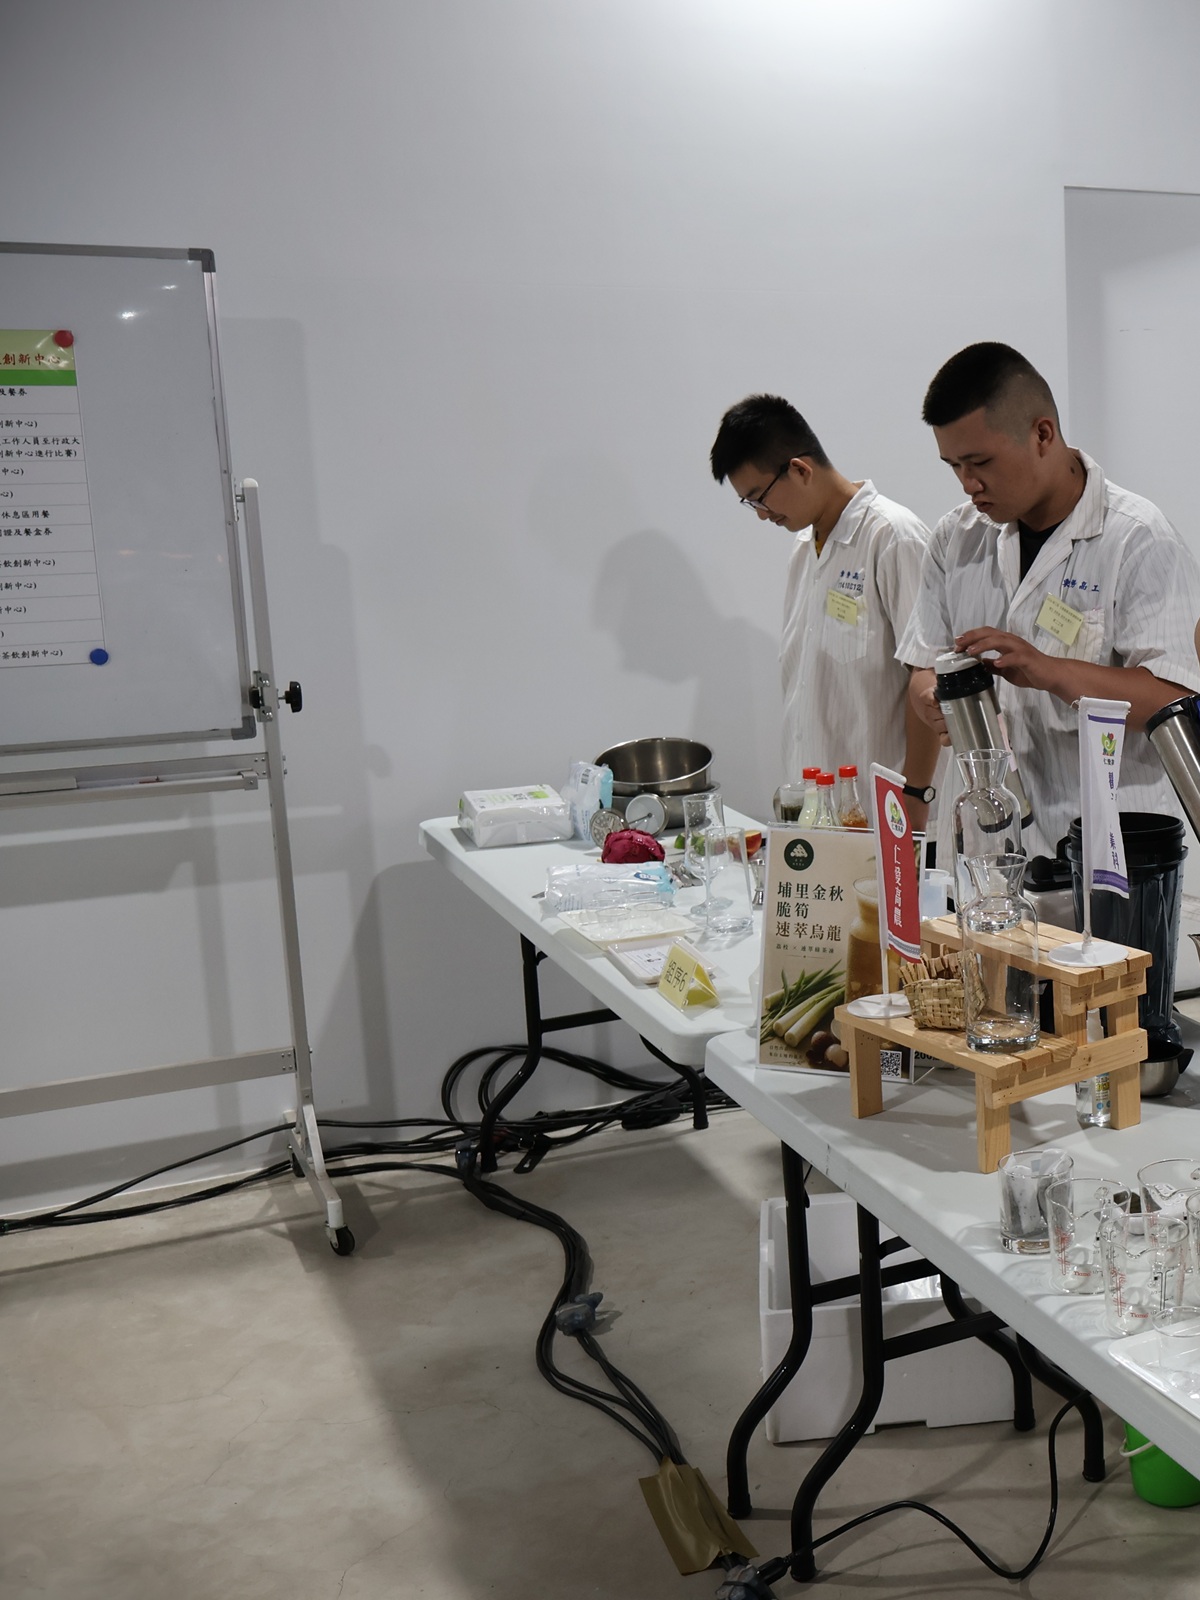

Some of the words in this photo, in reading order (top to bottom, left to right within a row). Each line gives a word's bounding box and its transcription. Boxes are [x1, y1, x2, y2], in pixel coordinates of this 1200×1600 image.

[0, 353, 61, 366] 創新中心
[0, 436, 80, 446] 工作人員至行政大
[0, 527, 52, 537] 證及餐盒券
[0, 558, 56, 568] 飲創新中心)
[777, 881, 844, 902] 埔里金秋
[776, 901, 809, 919] 脆筍
[775, 921, 842, 942] 速萃烏龍
